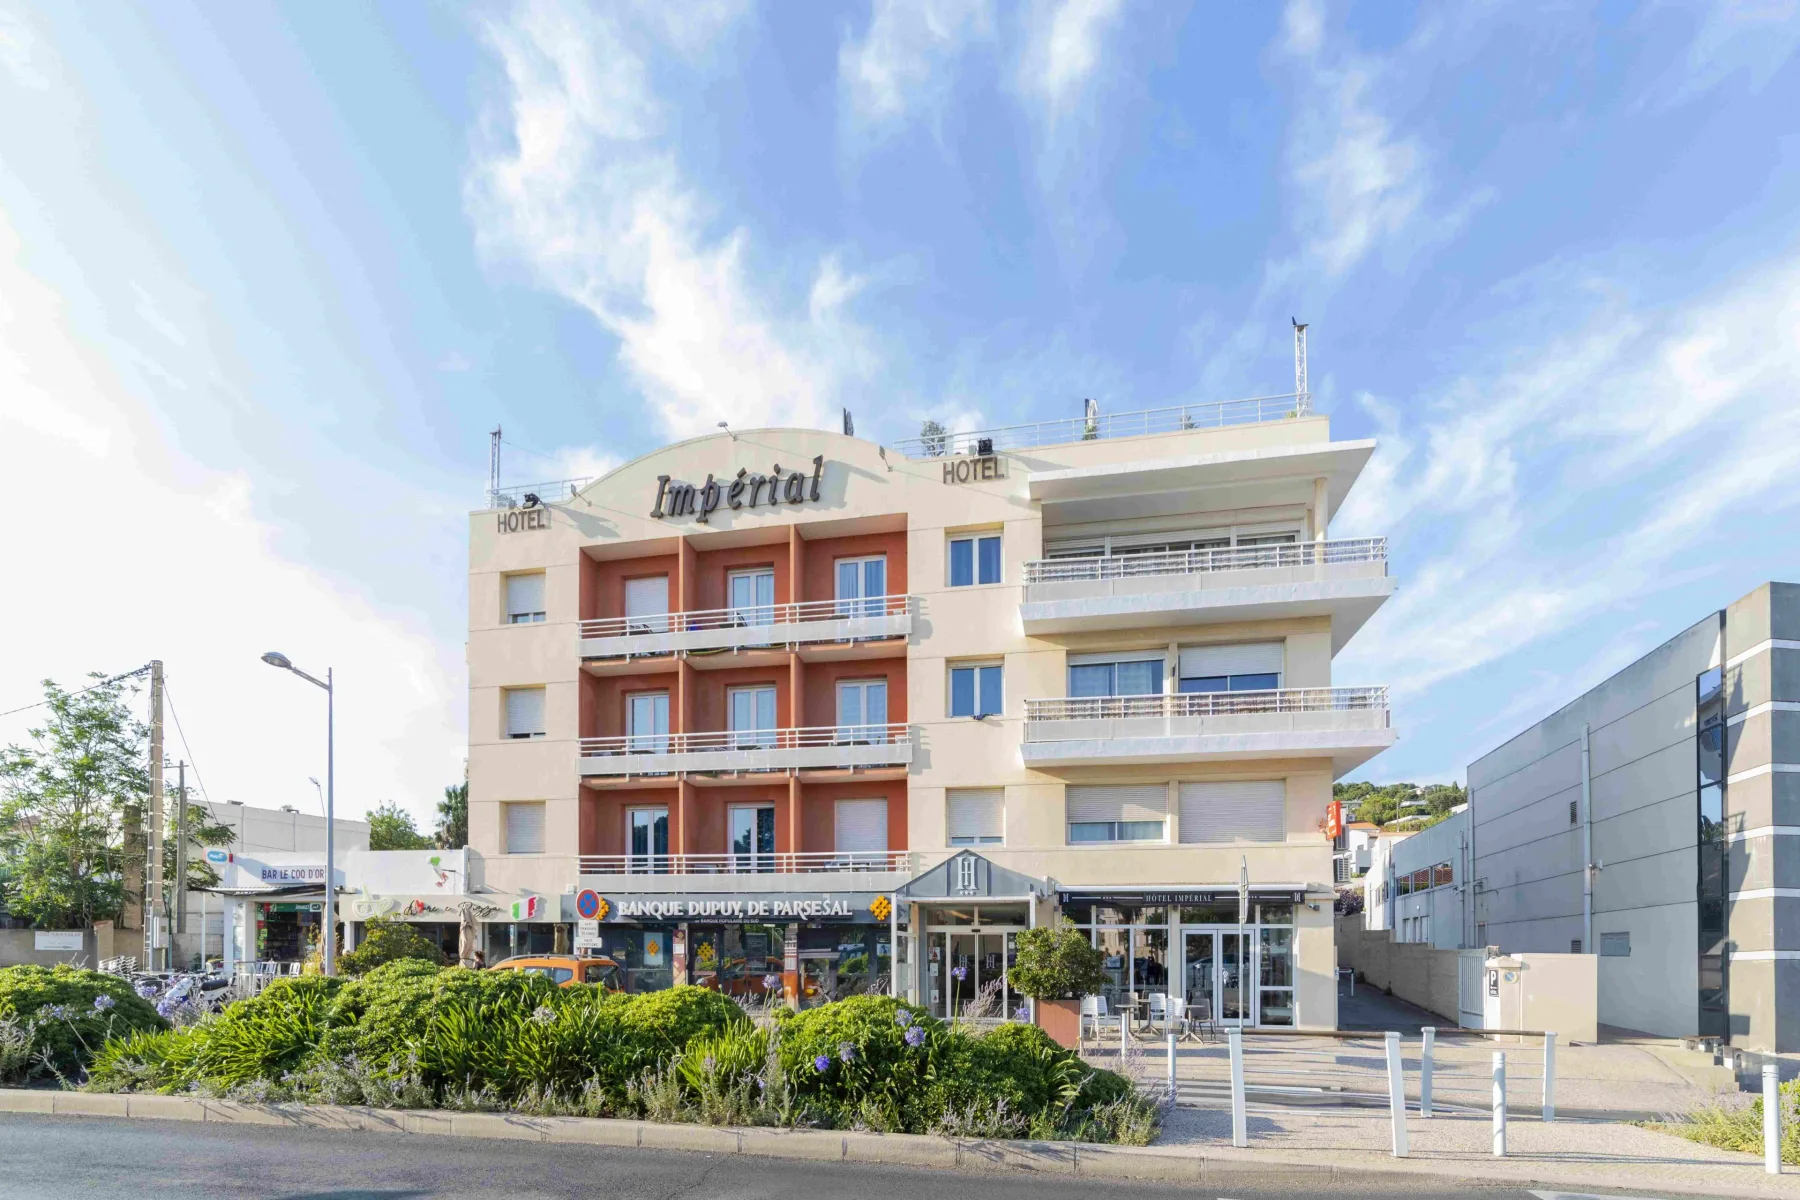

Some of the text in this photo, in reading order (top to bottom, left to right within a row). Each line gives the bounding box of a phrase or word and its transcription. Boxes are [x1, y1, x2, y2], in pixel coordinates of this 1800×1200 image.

[943, 456, 1005, 484] HOTEL
[650, 455, 823, 523] Impérial
[497, 509, 546, 533] HOTEL
[262, 869, 277, 880] BAR
[280, 869, 289, 880] LE
[308, 869, 325, 879] D'OR
[618, 900, 684, 920] BANQUE
[688, 900, 744, 919] DUPUY,
[747, 900, 769, 916] DE
[1491, 971, 1497, 985] P
